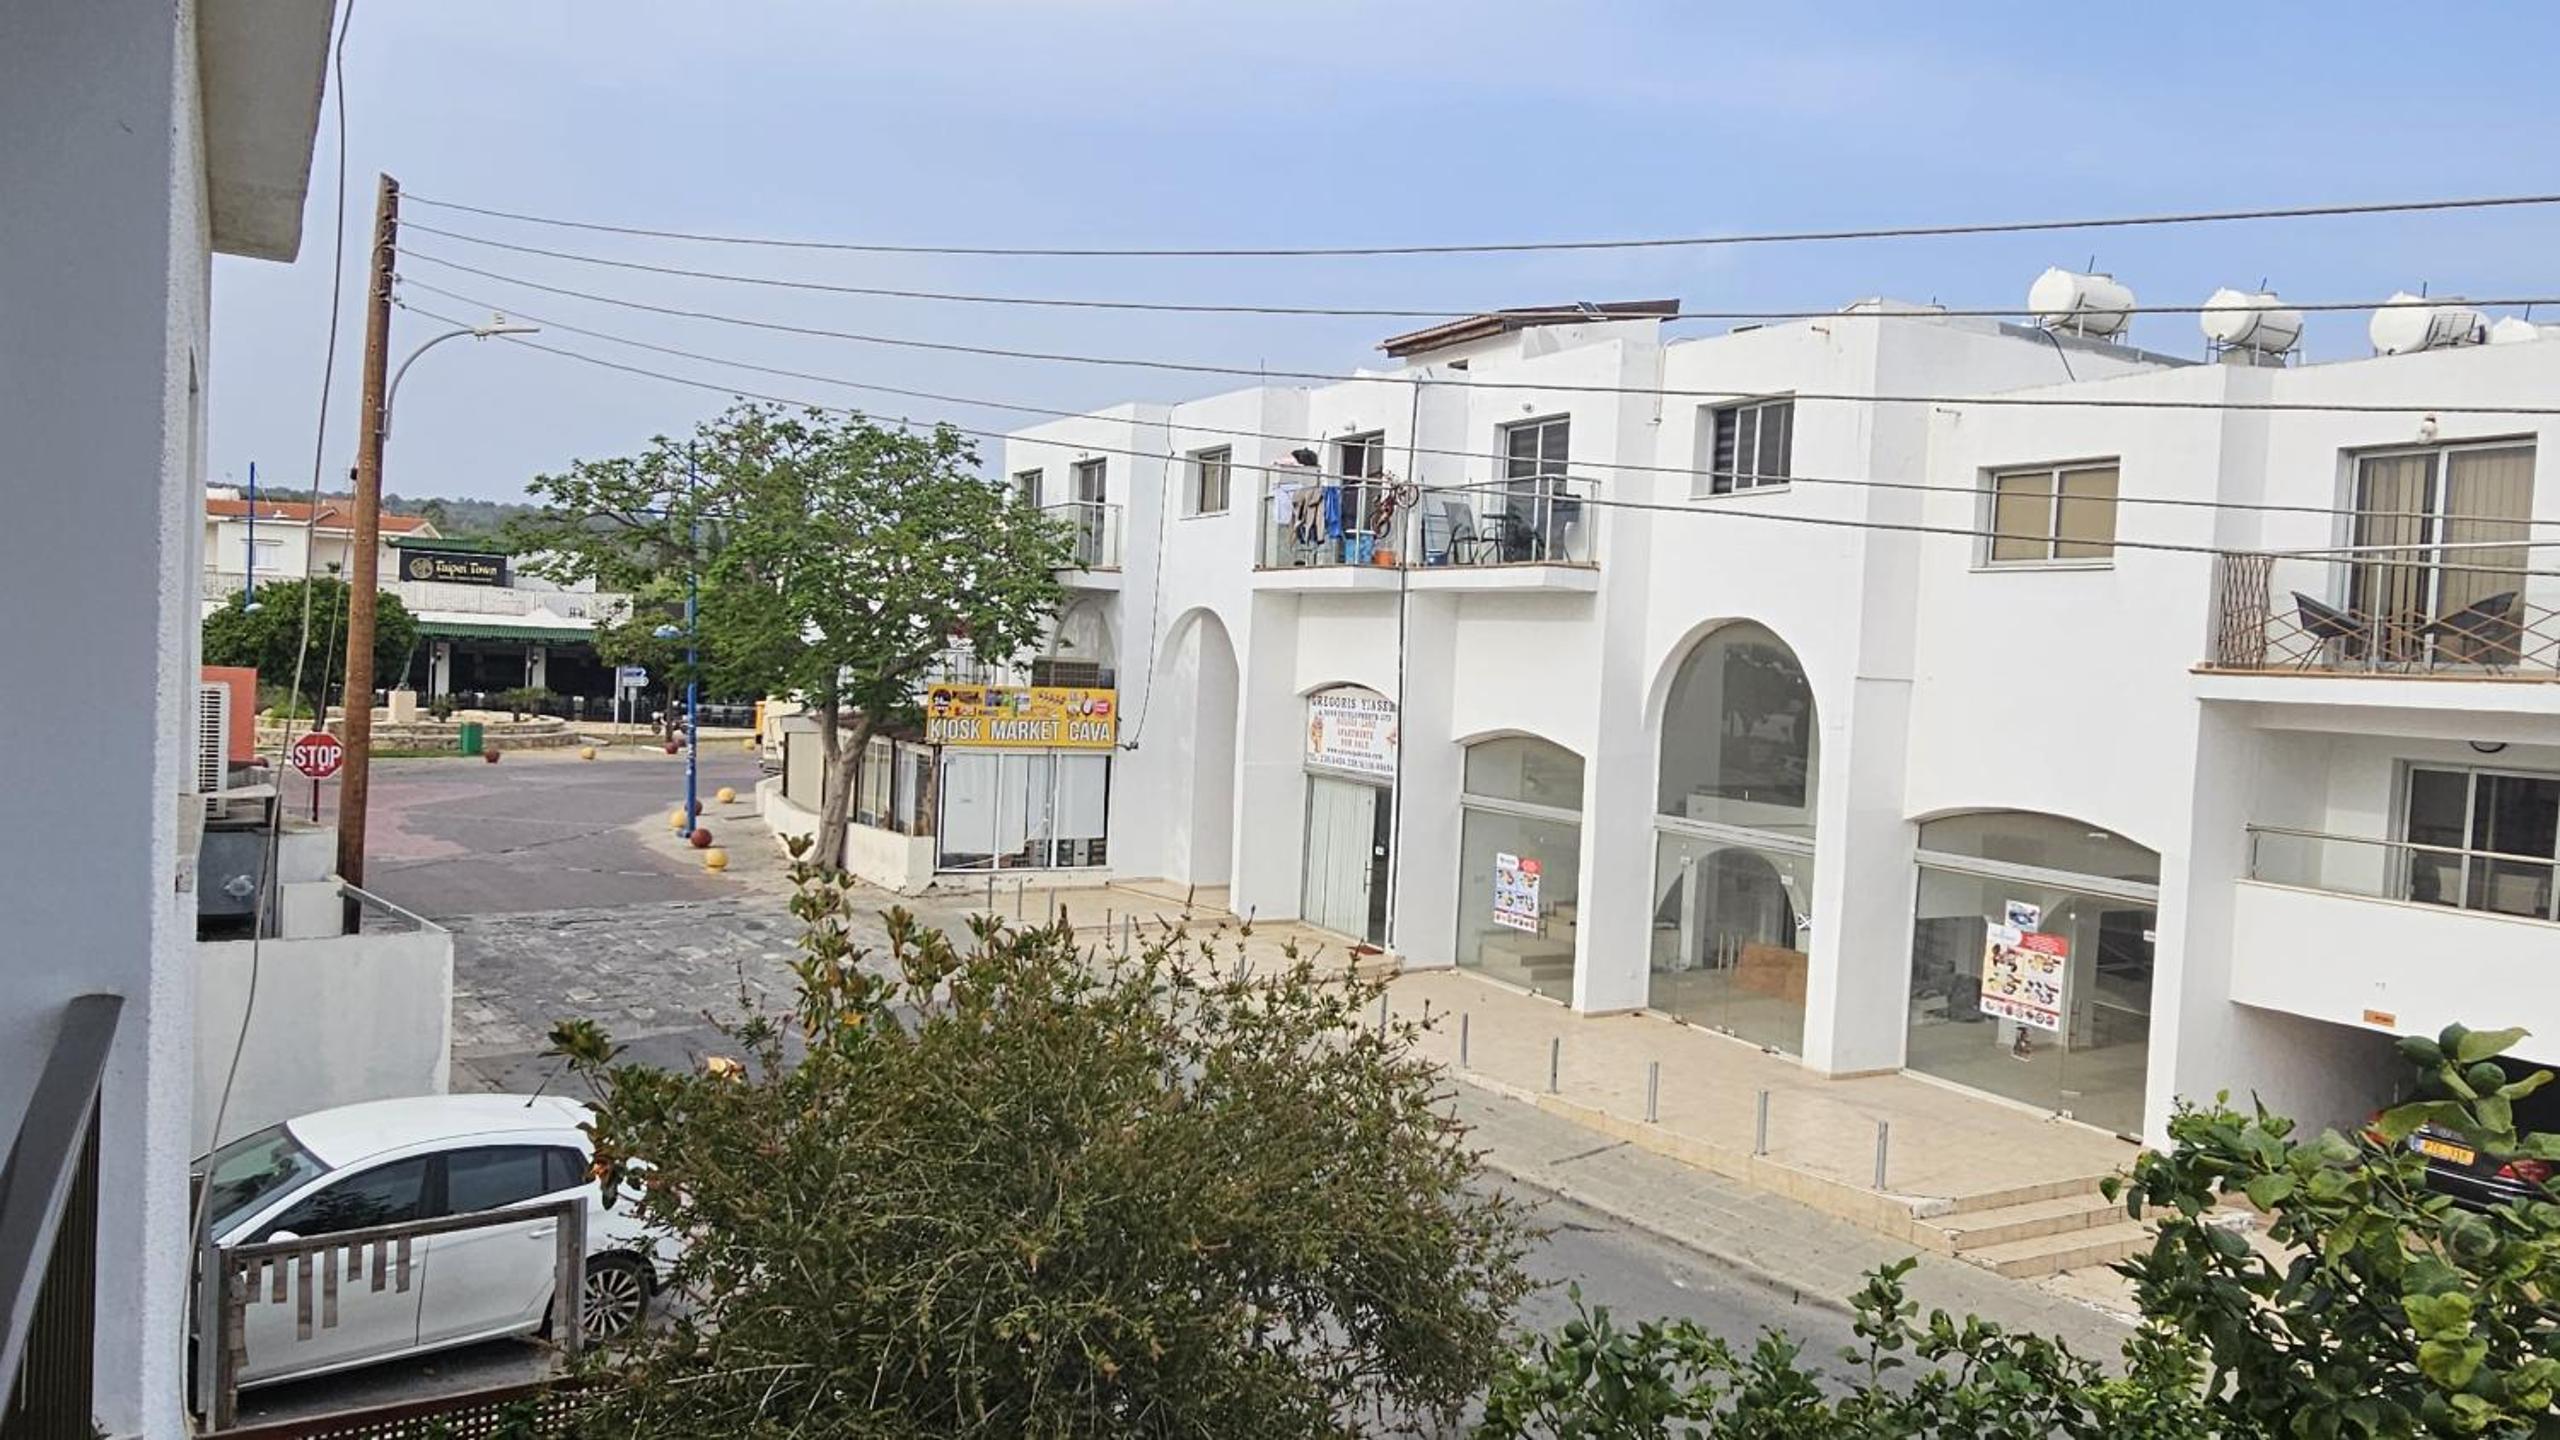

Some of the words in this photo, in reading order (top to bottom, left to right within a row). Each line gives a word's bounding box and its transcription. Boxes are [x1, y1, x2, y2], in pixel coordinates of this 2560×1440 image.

[435, 560, 467, 576] Taipei
[469, 562, 497, 575] Town
[930, 719, 981, 740] KIOSK
[990, 719, 1061, 741] MARKET
[1069, 721, 1111, 742] CAVA
[294, 745, 342, 768] STOP
